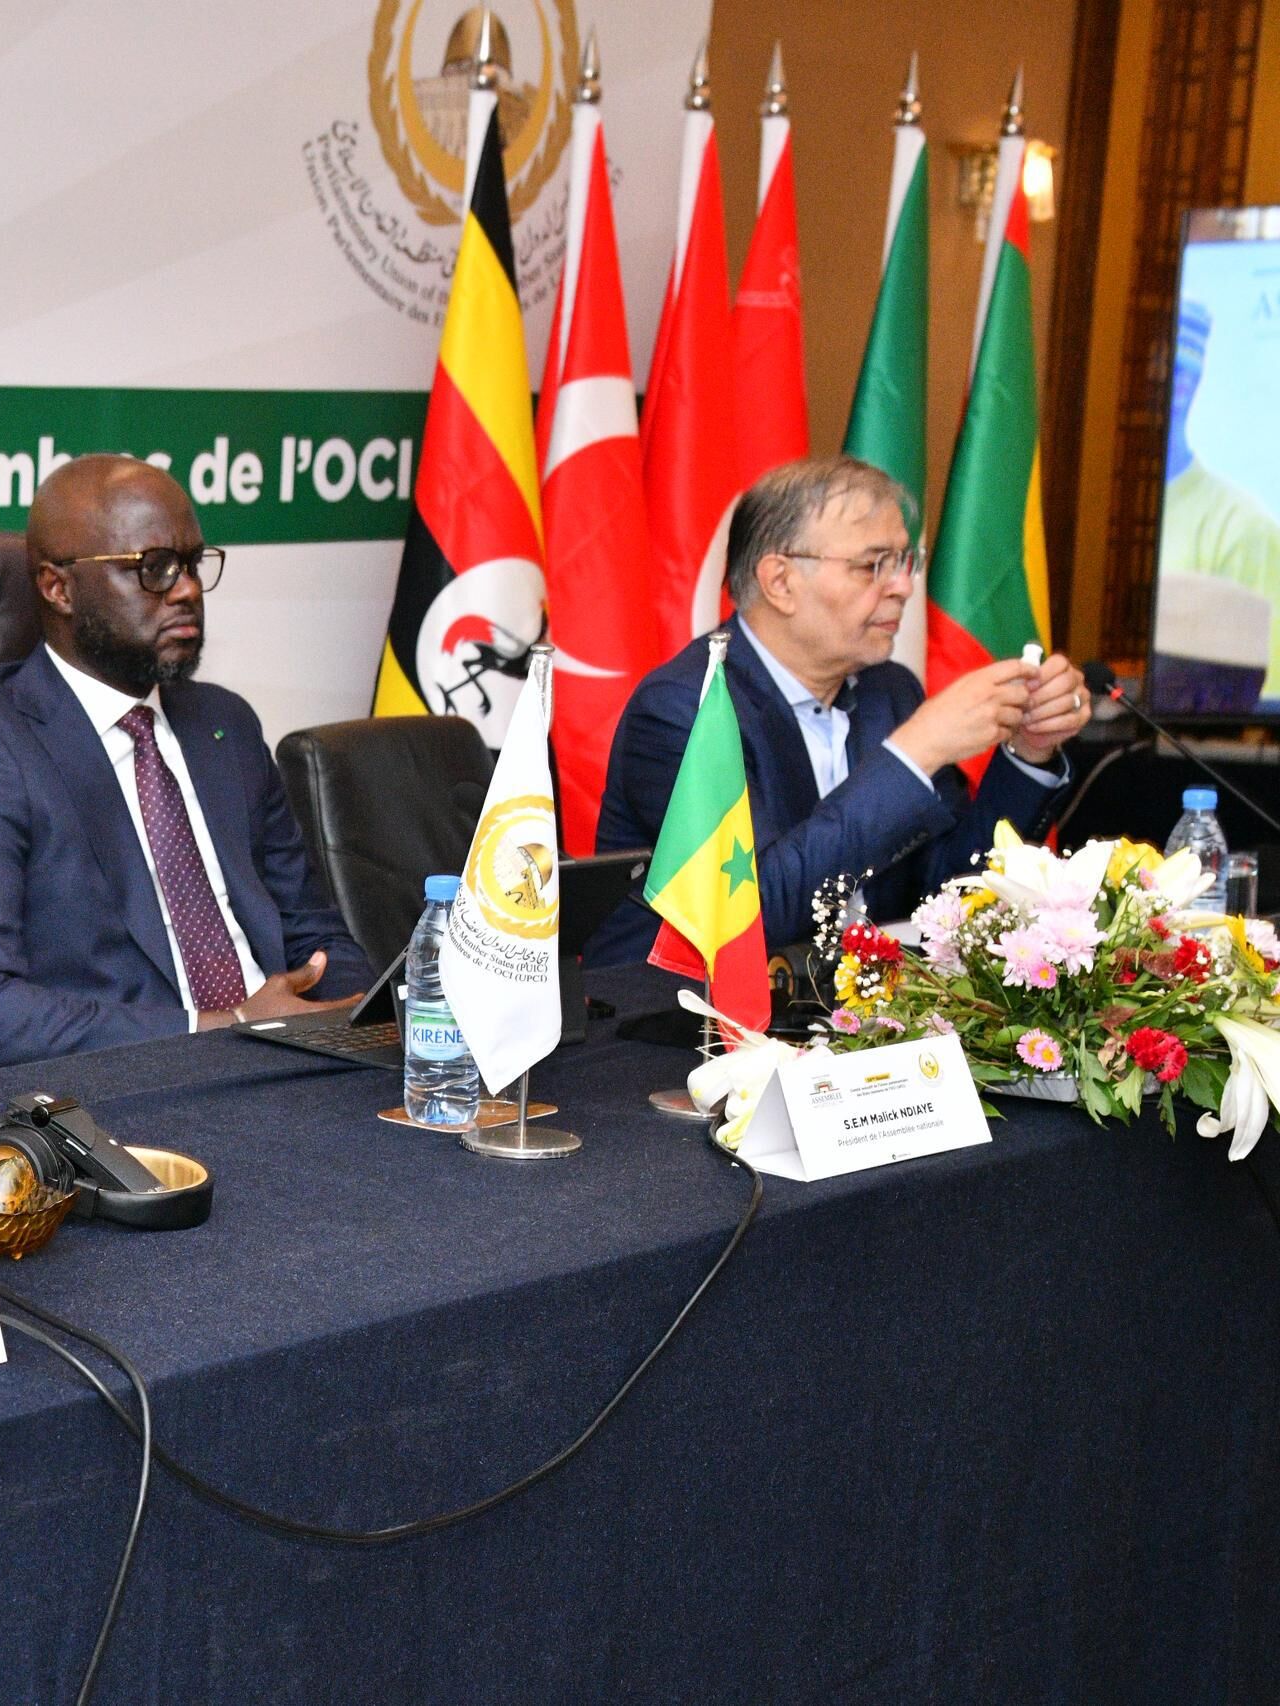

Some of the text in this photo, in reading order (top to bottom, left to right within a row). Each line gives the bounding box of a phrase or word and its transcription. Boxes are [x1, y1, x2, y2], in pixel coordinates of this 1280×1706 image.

[189, 436, 263, 505] de
[460, 931, 488, 957] Member
[490, 953, 515, 970] States
[516, 962, 548, 973] (PUIC)
[472, 955, 483, 967] de
[515, 974, 548, 983] (UPCI)
[843, 1102, 934, 1130] S.E.M Malick NDIAYE
[837, 1134, 869, 1147] Président
[869, 1132, 878, 1142] de
[916, 1119, 944, 1131] nationale
